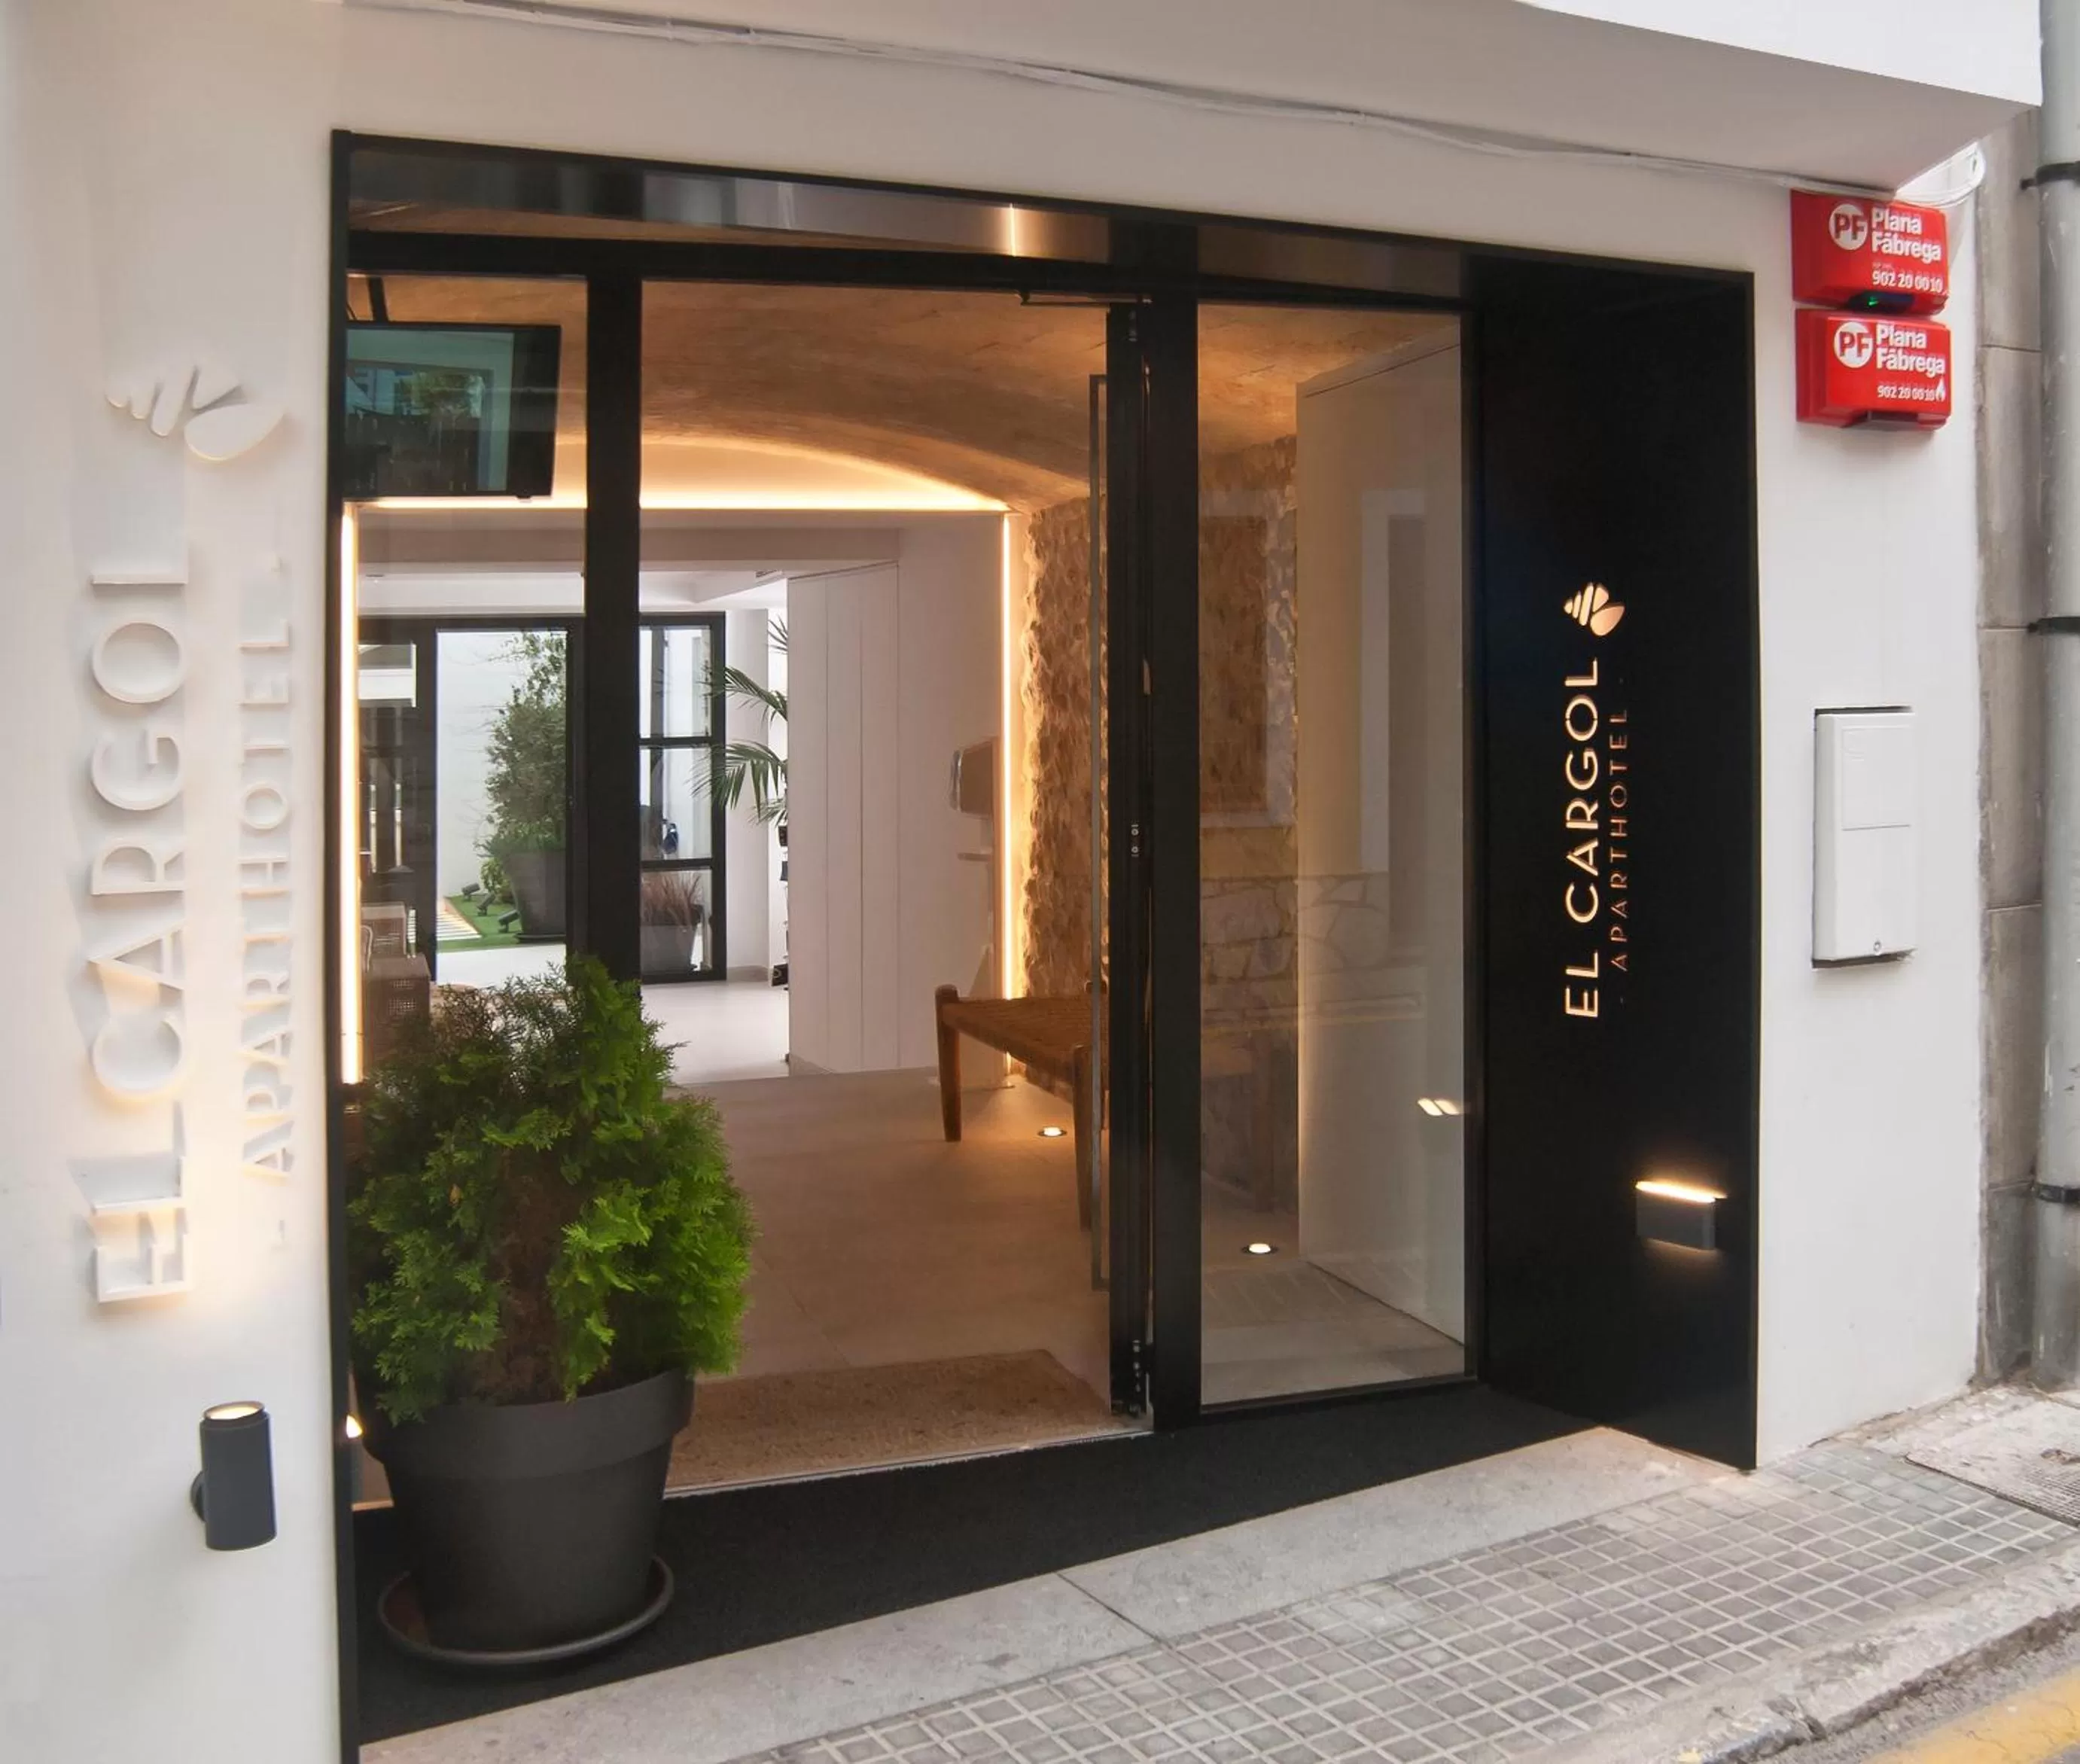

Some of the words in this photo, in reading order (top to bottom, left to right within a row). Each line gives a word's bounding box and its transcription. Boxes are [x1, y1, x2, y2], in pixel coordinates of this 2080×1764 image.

[1834, 213, 1866, 240] PF
[1871, 207, 1922, 235] Plana
[1872, 270, 1896, 286] 902
[1839, 331, 1872, 358] PF
[1876, 324, 1926, 349] Plana
[1877, 385, 1897, 398] 902
[87, 531, 188, 1098] CARGOL
[1564, 657, 1599, 924] CARGOL
[1609, 709, 1628, 972] APARTHOTEL
[238, 617, 291, 1181] APARTHOTEL
[1565, 949, 1599, 1018] EL
[92, 1153, 190, 1304] EL
